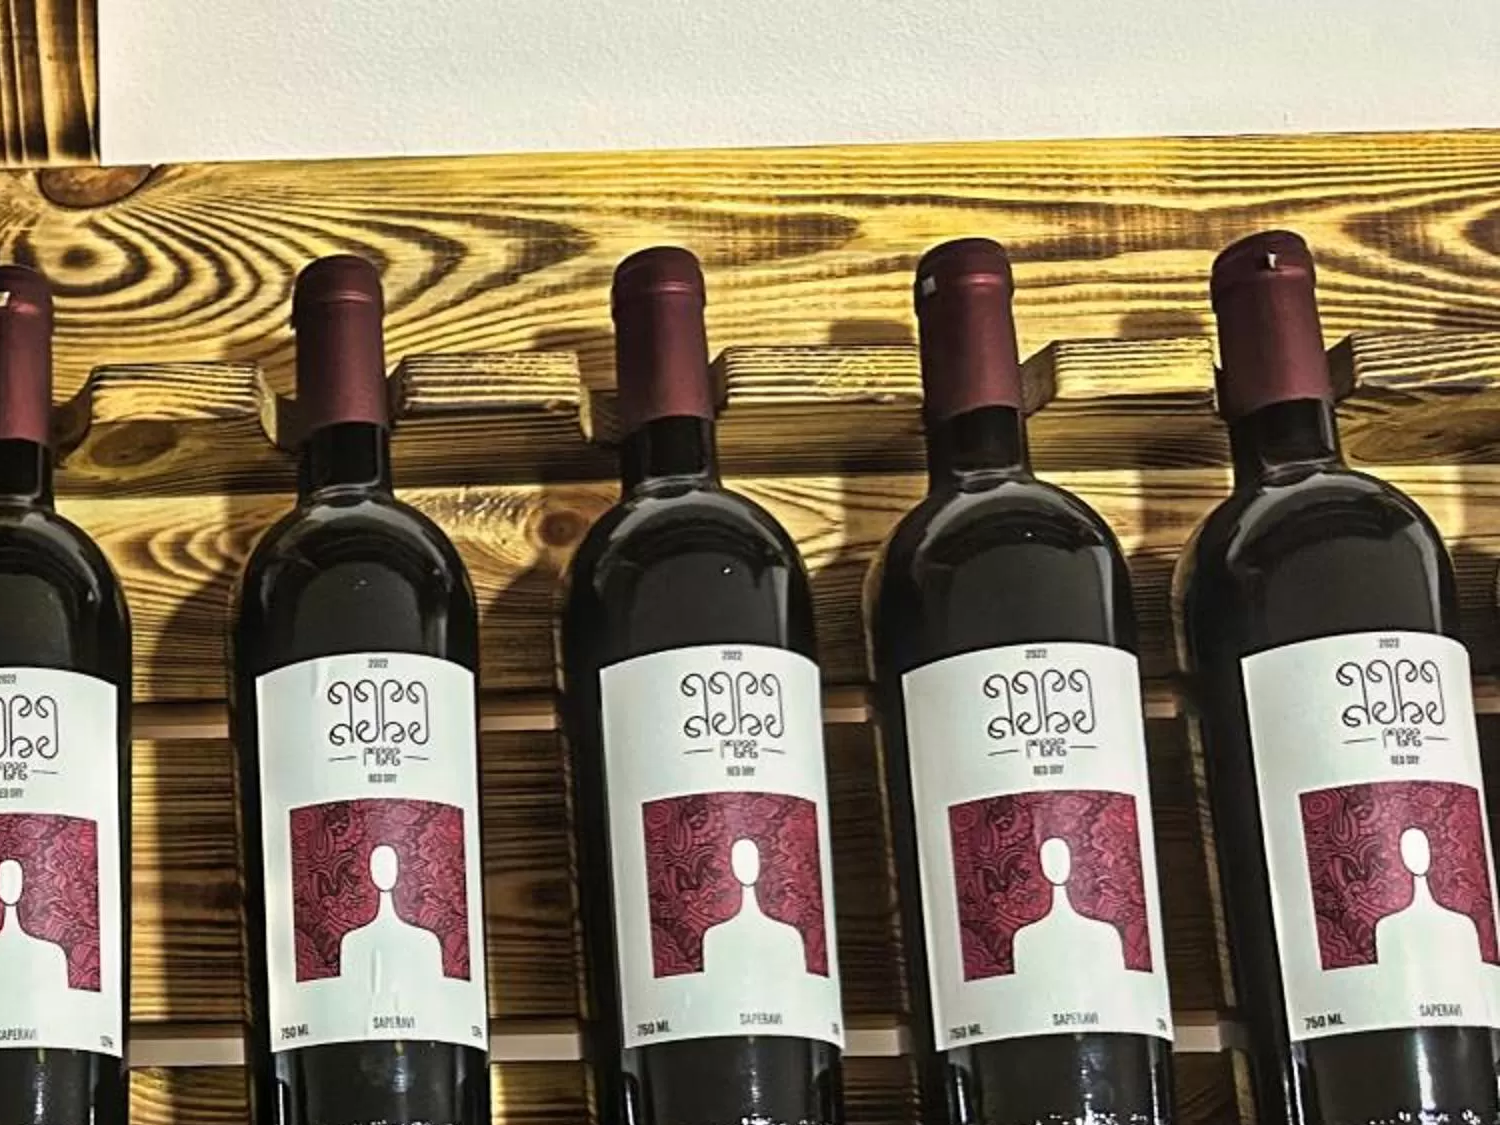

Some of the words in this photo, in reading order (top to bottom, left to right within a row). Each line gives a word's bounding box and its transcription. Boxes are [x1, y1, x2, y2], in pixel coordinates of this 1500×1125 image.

[1420, 1004, 1462, 1017] SAPERAVI
[373, 1016, 415, 1029] SAPERAVI
[740, 1012, 782, 1024] SAPERAVI
[1053, 1012, 1099, 1026] SAPERAVI
[1305, 1016, 1326, 1030] 750
[1327, 1013, 1344, 1025] ML
[281, 1025, 296, 1040] 750
[298, 1024, 308, 1037] ML
